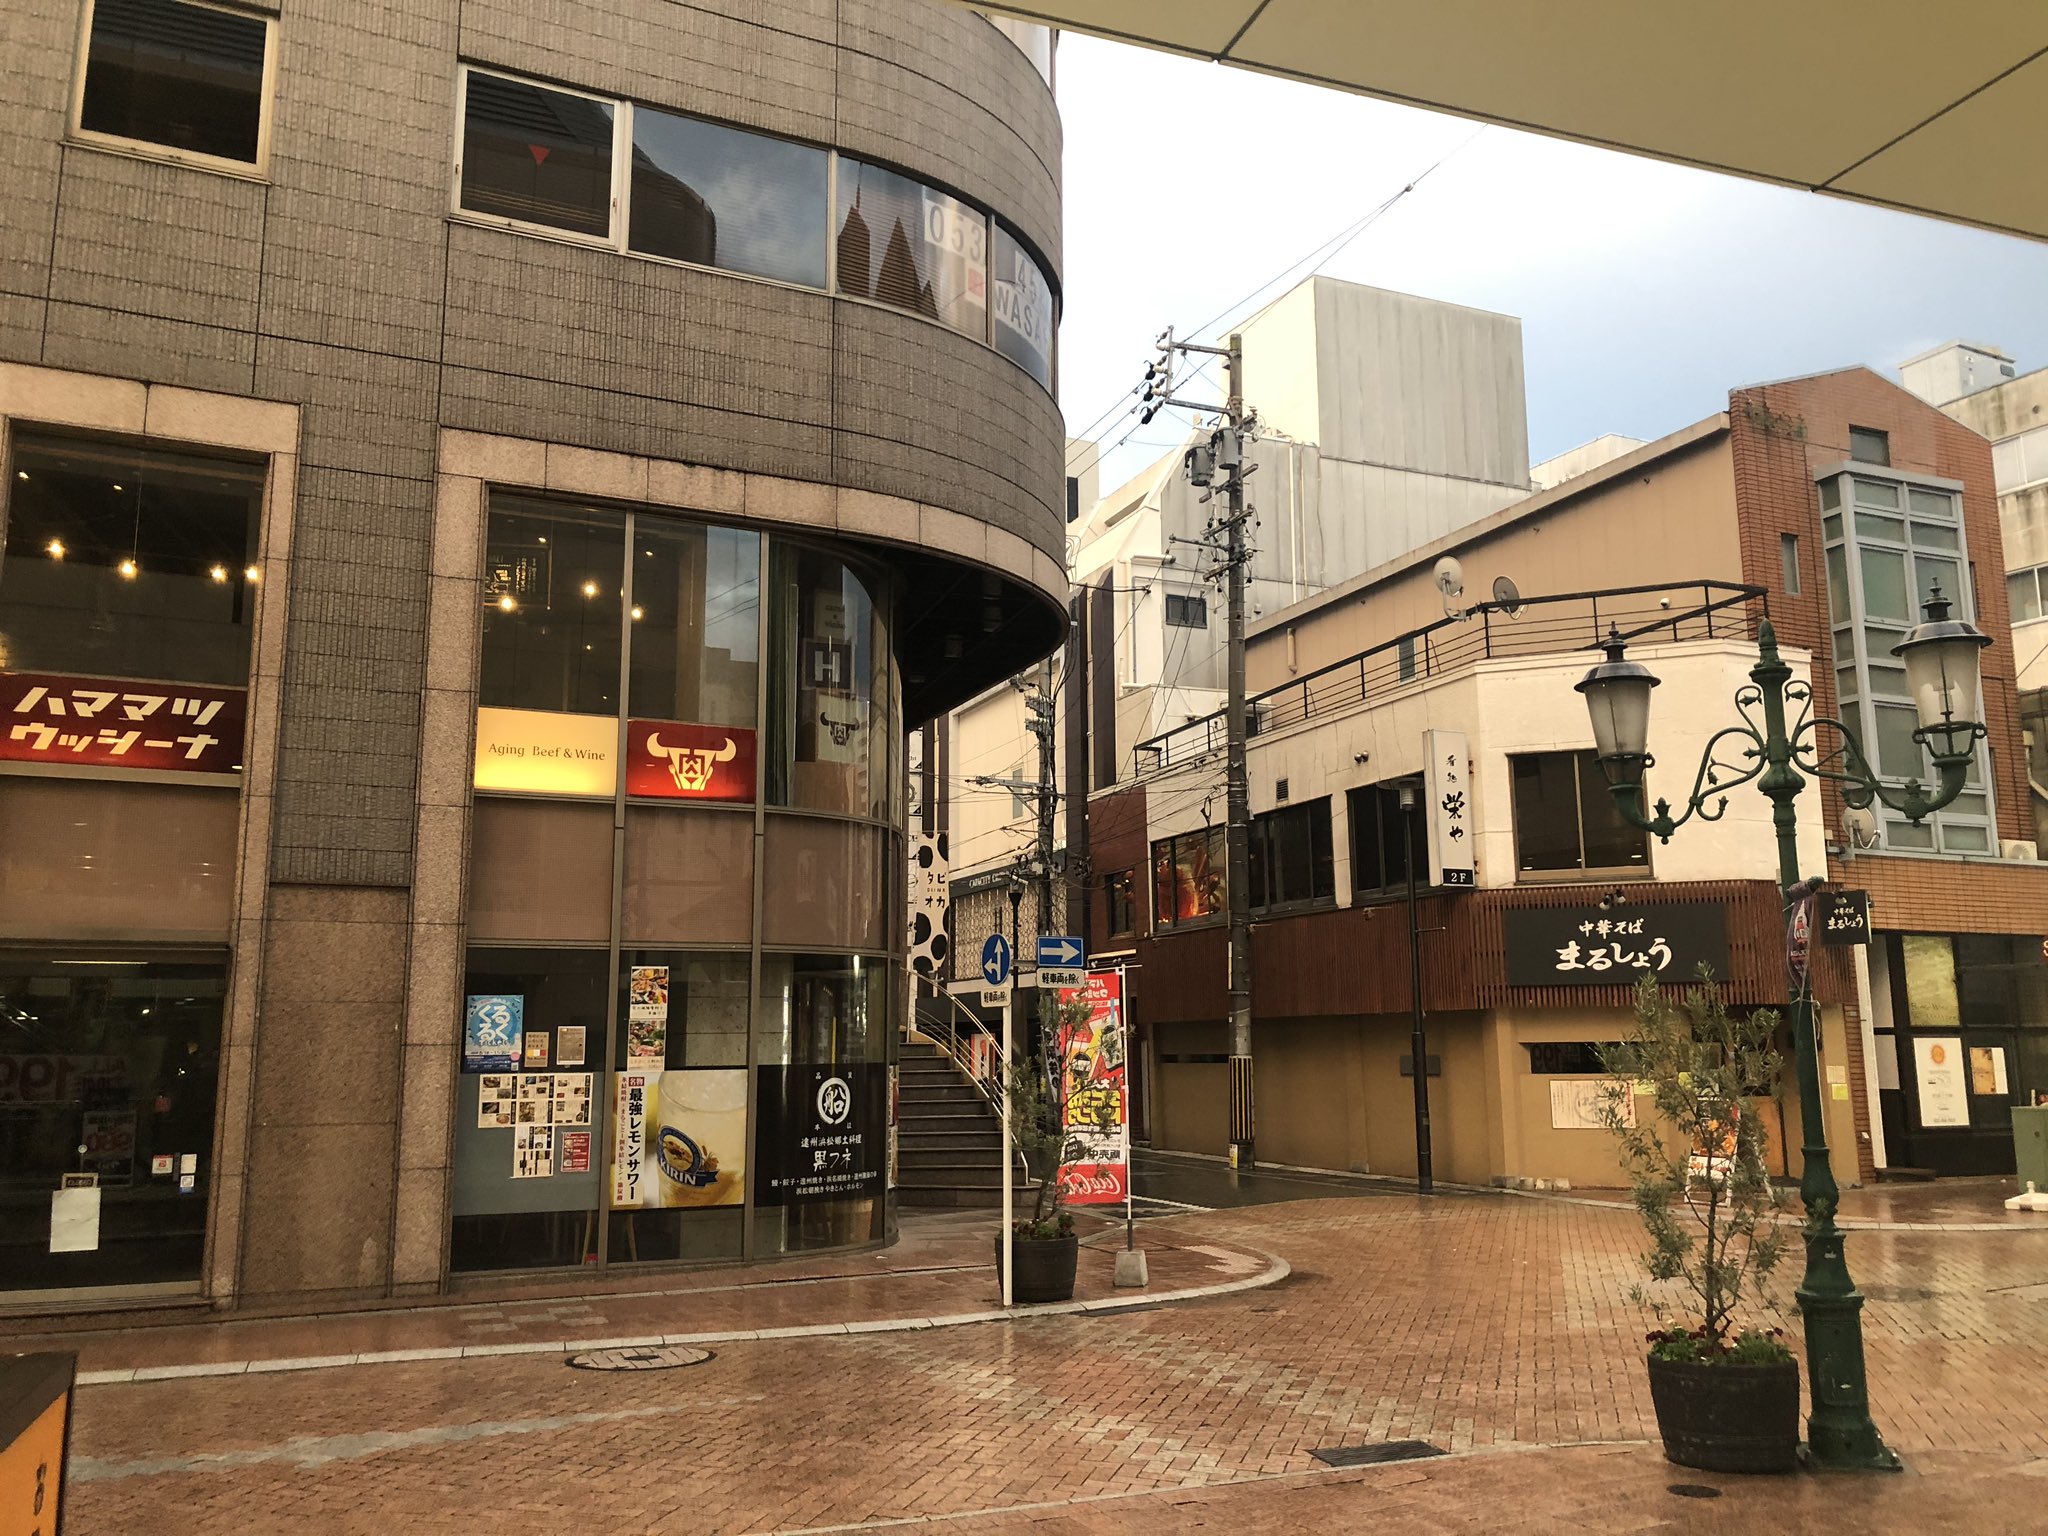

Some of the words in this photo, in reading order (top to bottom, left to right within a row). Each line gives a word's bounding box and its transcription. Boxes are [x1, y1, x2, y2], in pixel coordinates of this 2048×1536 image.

[12, 686, 226, 726] ハママツ
[9, 722, 219, 760] ウッシーナ
[488, 743, 525, 757] Aging
[532, 745, 561, 758] Beef
[563, 747, 573, 758] &
[575, 748, 606, 761] Wine
[1450, 872, 1467, 883] 2F
[1578, 917, 1645, 940] 中華そば
[1827, 913, 1864, 930] まるしょう
[1555, 937, 1672, 971] まるしょう
[1041, 972, 1080, 985] 軽車両を除く
[983, 990, 1008, 1003] 軽車両を除く
[626, 1087, 644, 1200] 最強レモンサワー
[660, 1157, 697, 1186] KIRIN
[812, 1148, 852, 1172] 黒フネ
